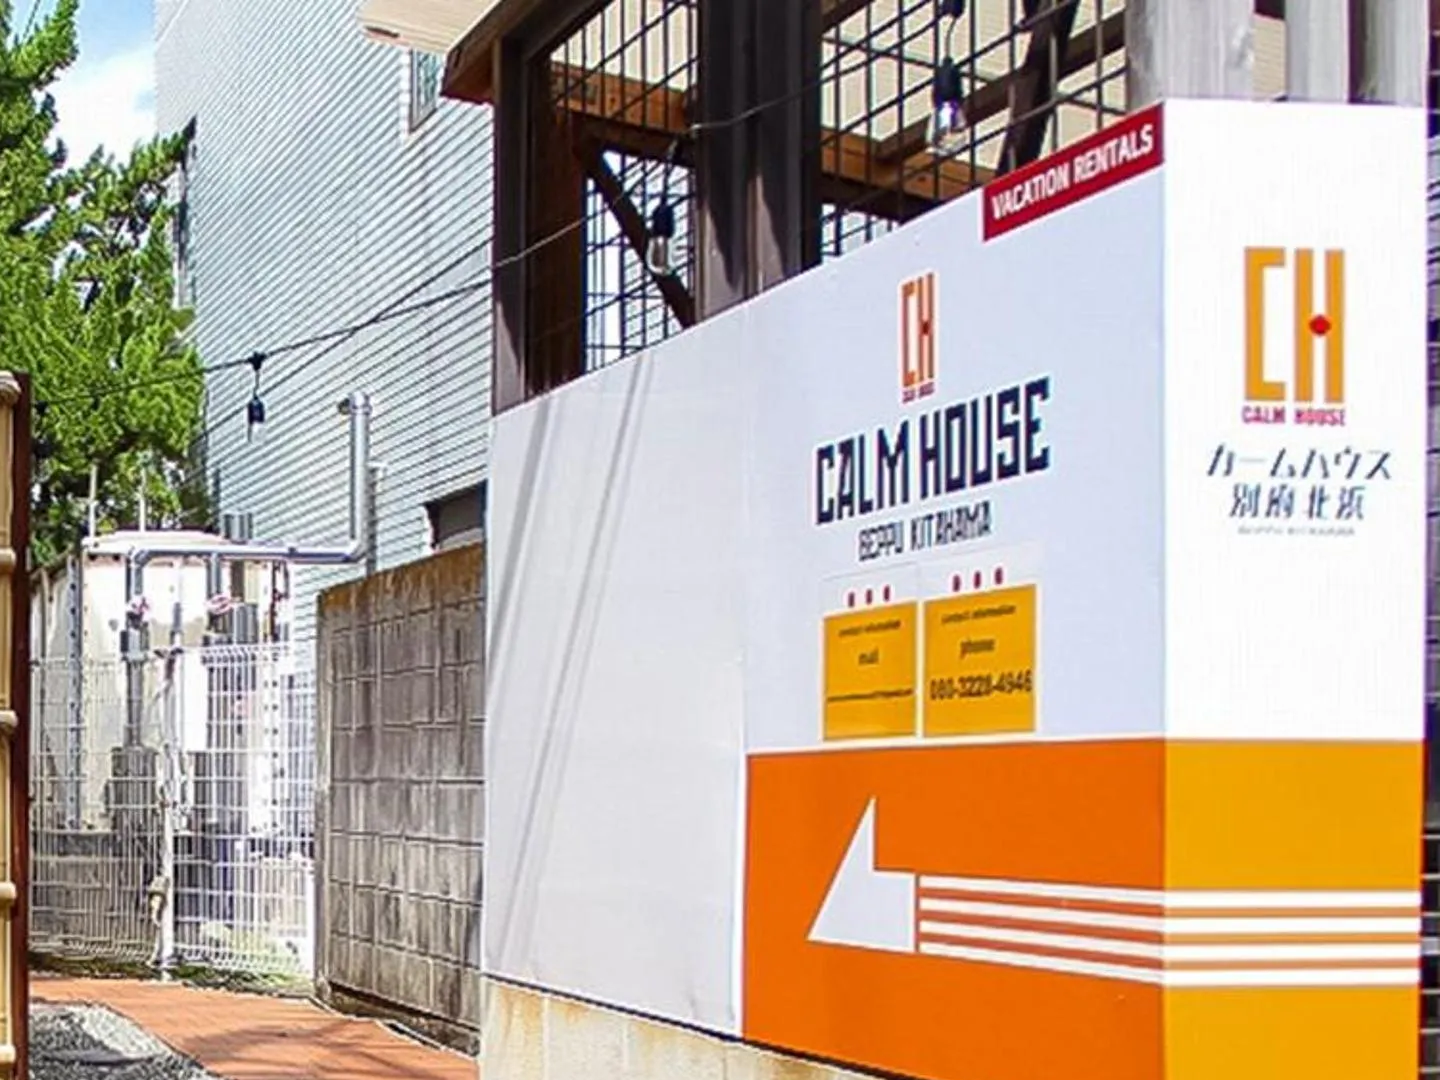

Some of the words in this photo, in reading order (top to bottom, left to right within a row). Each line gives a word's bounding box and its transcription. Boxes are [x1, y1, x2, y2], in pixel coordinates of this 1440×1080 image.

[992, 163, 1070, 219] VACATION
[1073, 124, 1153, 183] RENTALS
[815, 419, 910, 525] CALM
[919, 376, 1050, 499] HOUSE
[1242, 406, 1286, 425] CALM
[859, 520, 904, 562] BEPPU
[911, 500, 992, 551] KITAHAMA
